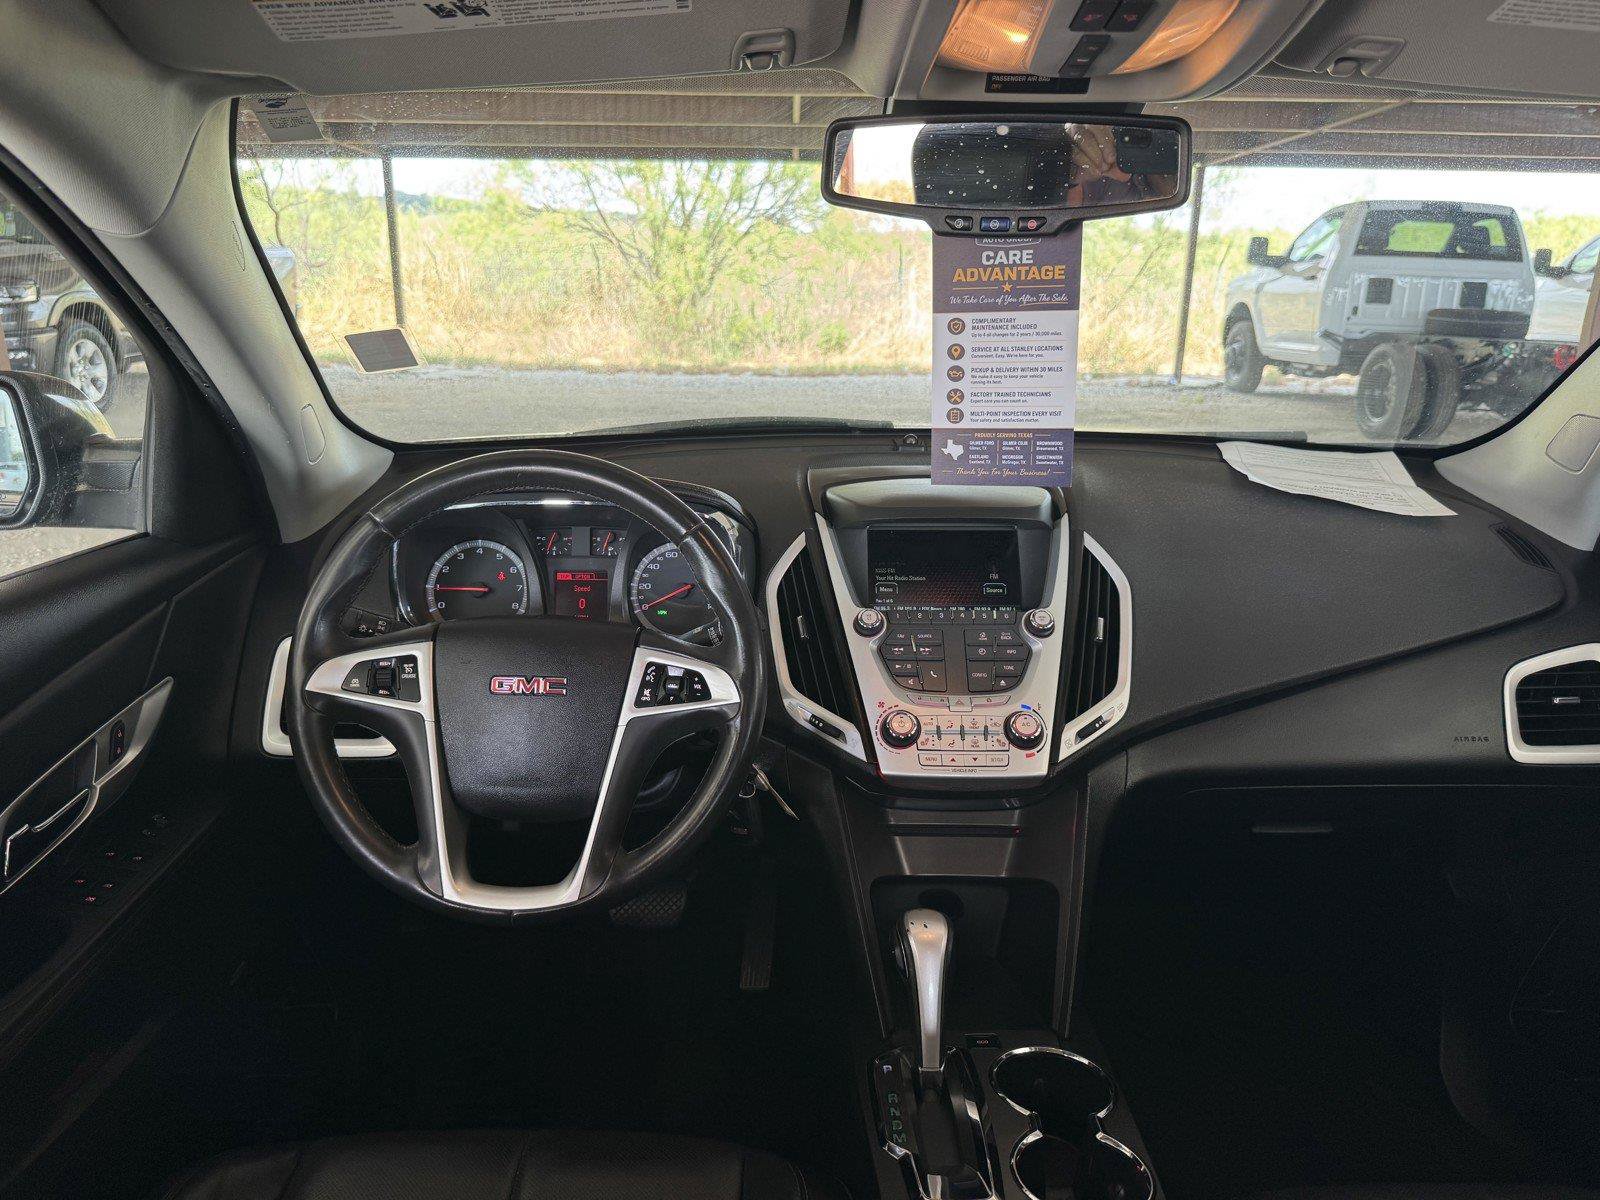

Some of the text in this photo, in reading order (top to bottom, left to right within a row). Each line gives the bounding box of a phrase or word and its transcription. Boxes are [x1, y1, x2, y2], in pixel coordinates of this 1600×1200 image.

[981, 249, 1034, 266] CARE
[952, 265, 1067, 283] ADVANTAGE
[949, 295, 962, 304] We
[962, 295, 978, 304] Take
[978, 295, 995, 304] Care
[995, 294, 1004, 306] of
[1003, 295, 1018, 306] You
[1018, 293, 1037, 303] After
[1038, 293, 1051, 303] The
[971, 317, 1017, 325] COMPLIMENTARY
[1010, 323, 1038, 331] INCLUDED
[955, 467, 976, 475] Thank
[977, 467, 990, 477] You
[1002, 467, 1019, 477] Your
[1019, 467, 1051, 476] Business!
[476, 547, 484, 555] 4
[665, 551, 679, 559] 60
[457, 552, 465, 560] 3
[509, 566, 517, 574] 6
[516, 584, 523, 592] 7
[573, 585, 591, 593] Speed
[638, 582, 652, 590] 20
[438, 601, 446, 609] 0
[511, 602, 519, 610] 8
[578, 598, 586, 610] 0
[490, 675, 568, 697] GMC
[883, 1064, 893, 1075] P
[889, 1107, 901, 1117] N
[892, 1120, 903, 1131] D
[893, 1133, 908, 1144] M
